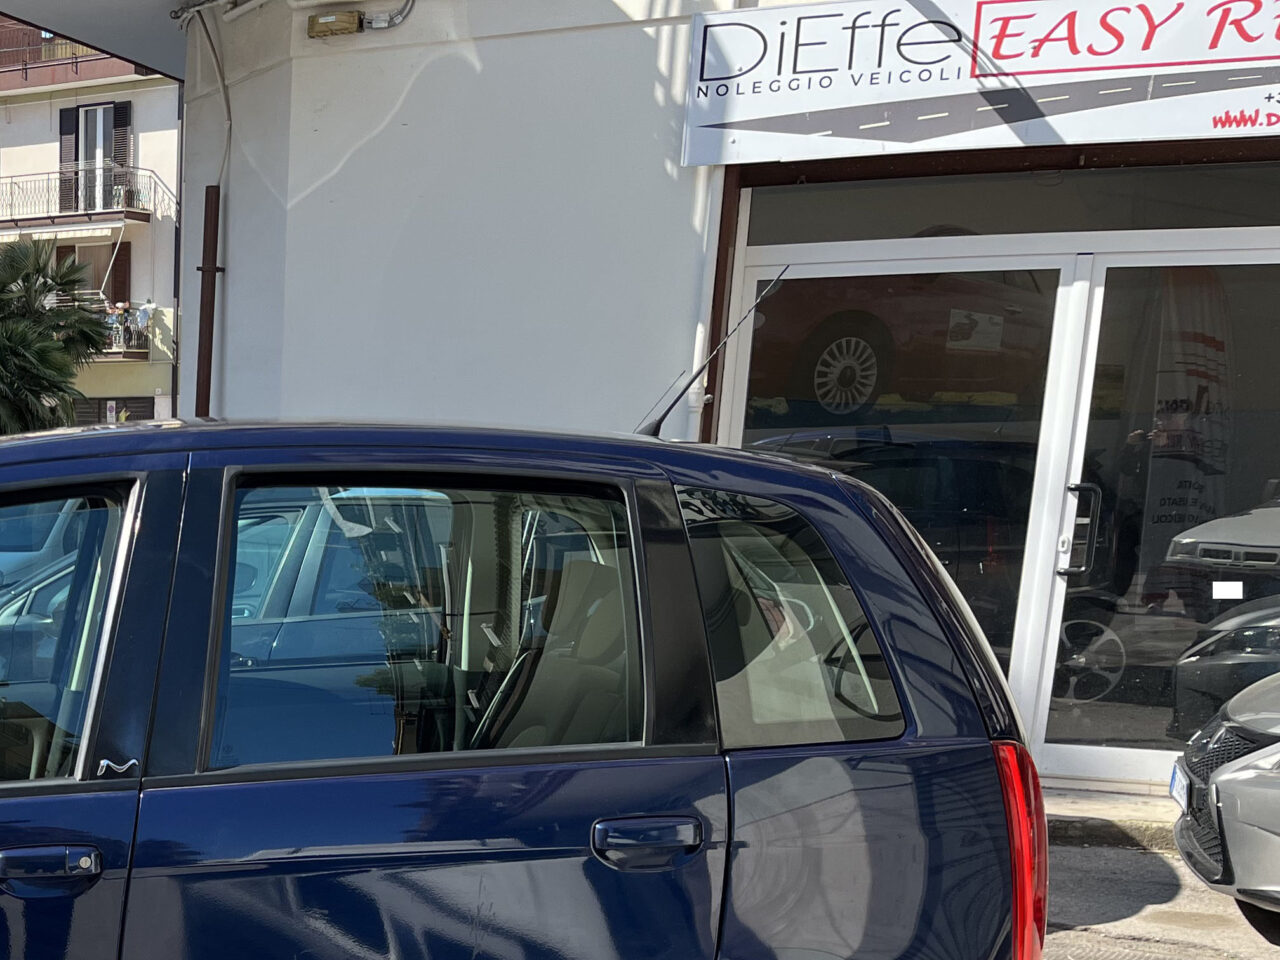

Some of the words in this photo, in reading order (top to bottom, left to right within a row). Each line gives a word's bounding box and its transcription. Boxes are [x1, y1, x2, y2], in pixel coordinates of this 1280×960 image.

[698, 9, 963, 82] DiEffe
[989, 2, 1185, 60] EASY
[1206, 0, 1280, 50] R
[696, 75, 833, 99] NOLEGGIO
[850, 66, 962, 87] VEICOLI
